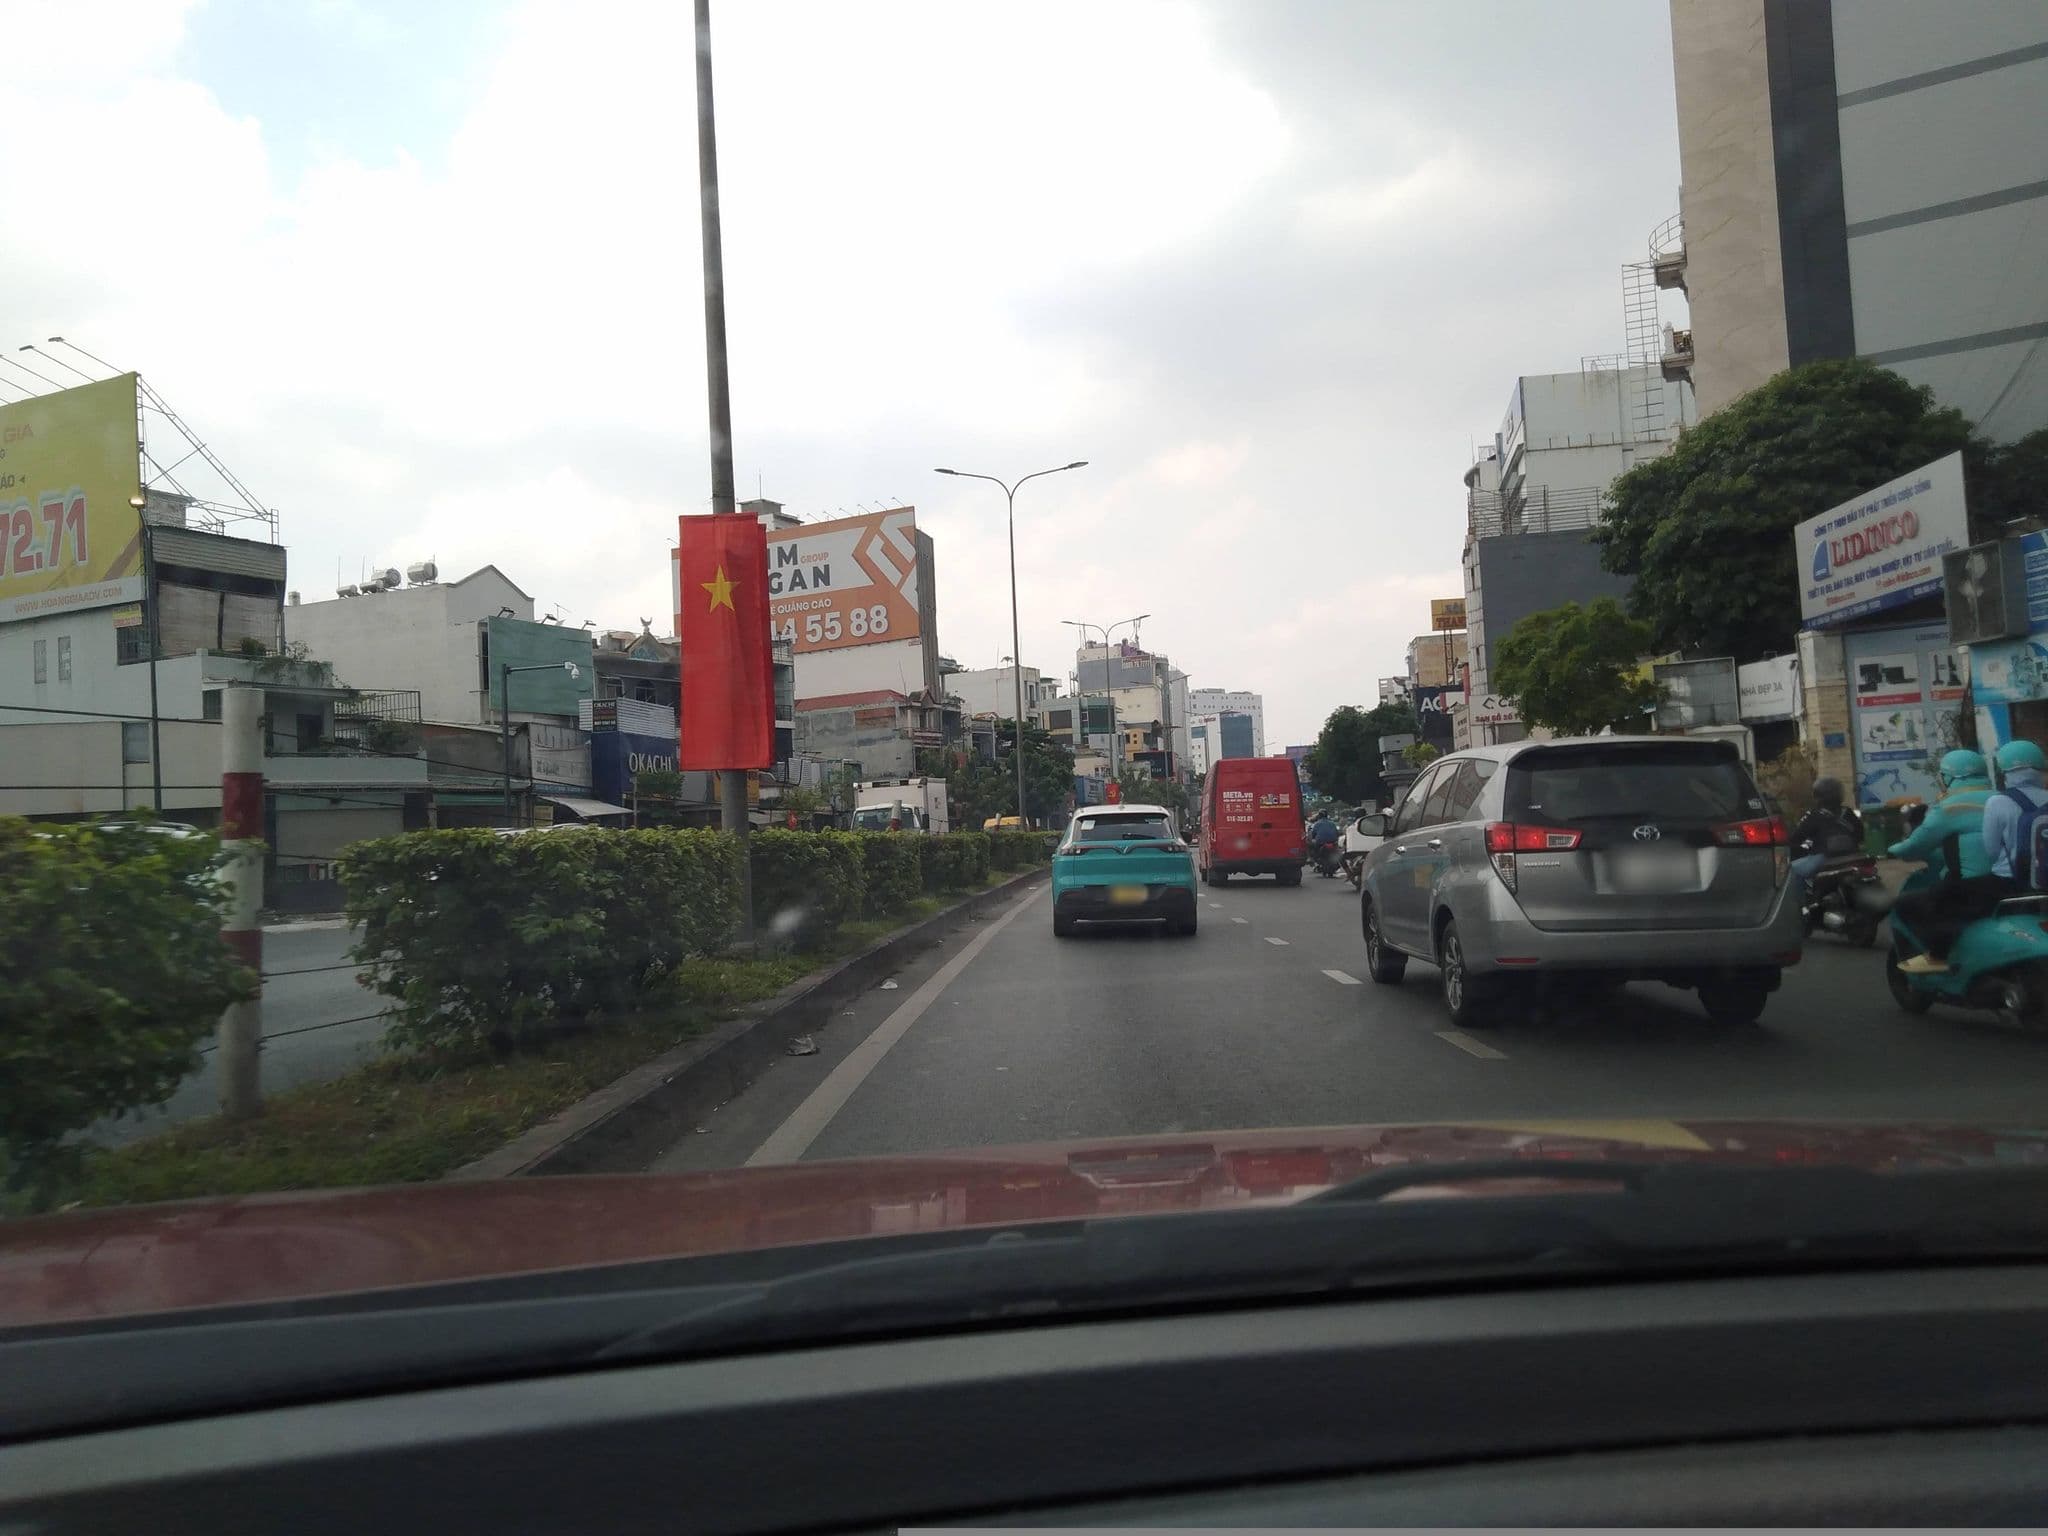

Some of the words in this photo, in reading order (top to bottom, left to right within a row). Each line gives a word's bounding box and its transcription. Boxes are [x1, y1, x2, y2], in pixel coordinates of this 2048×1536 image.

[1832, 510, 1919, 567] LIDINCO
[801, 552, 829, 564] GROUP
[769, 564, 830, 594] GAN
[806, 611, 842, 643] 55
[850, 604, 888, 637] 88
[628, 752, 672, 773] OKACHI
